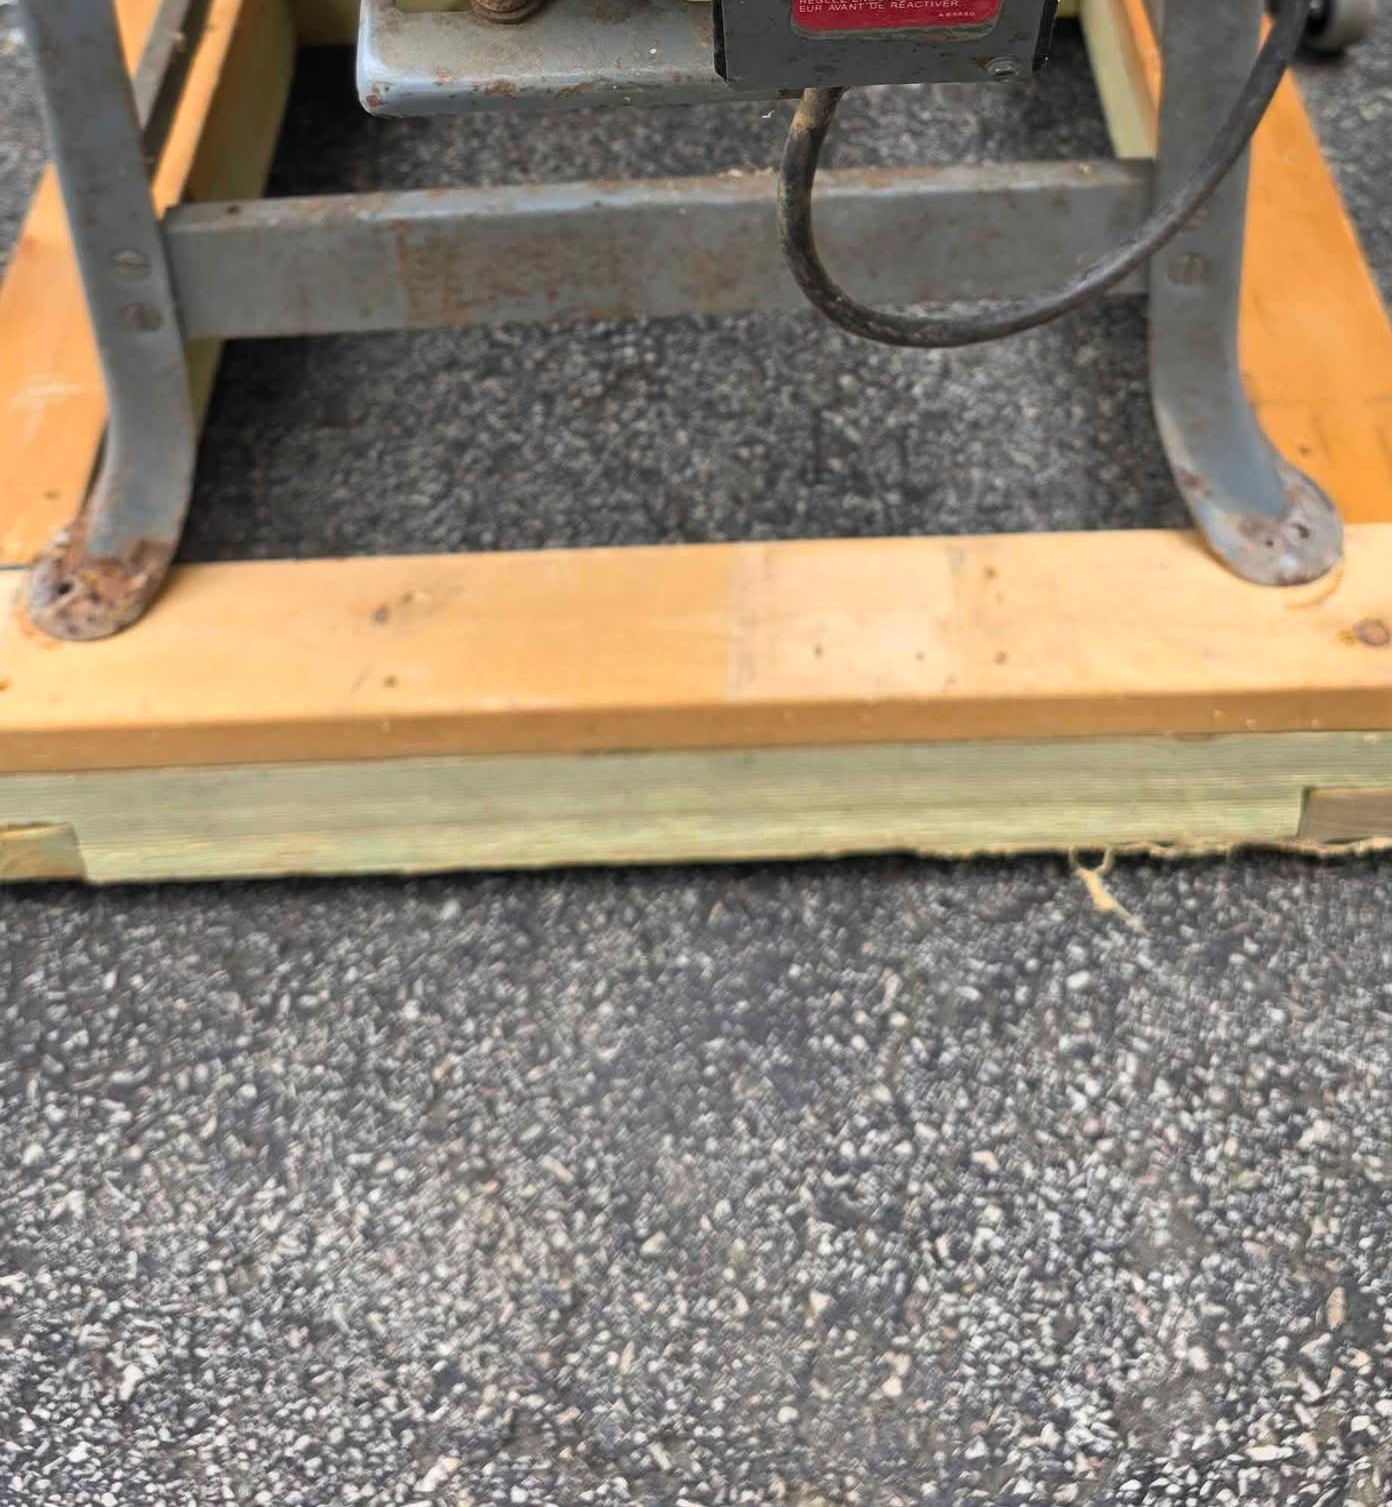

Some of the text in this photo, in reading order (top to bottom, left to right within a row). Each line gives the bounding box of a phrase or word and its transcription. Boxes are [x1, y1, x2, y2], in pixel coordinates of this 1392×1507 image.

[800, 4, 823, 13] EUR
[828, 2, 866, 11] AVANT
[869, 1, 886, 10] DE
